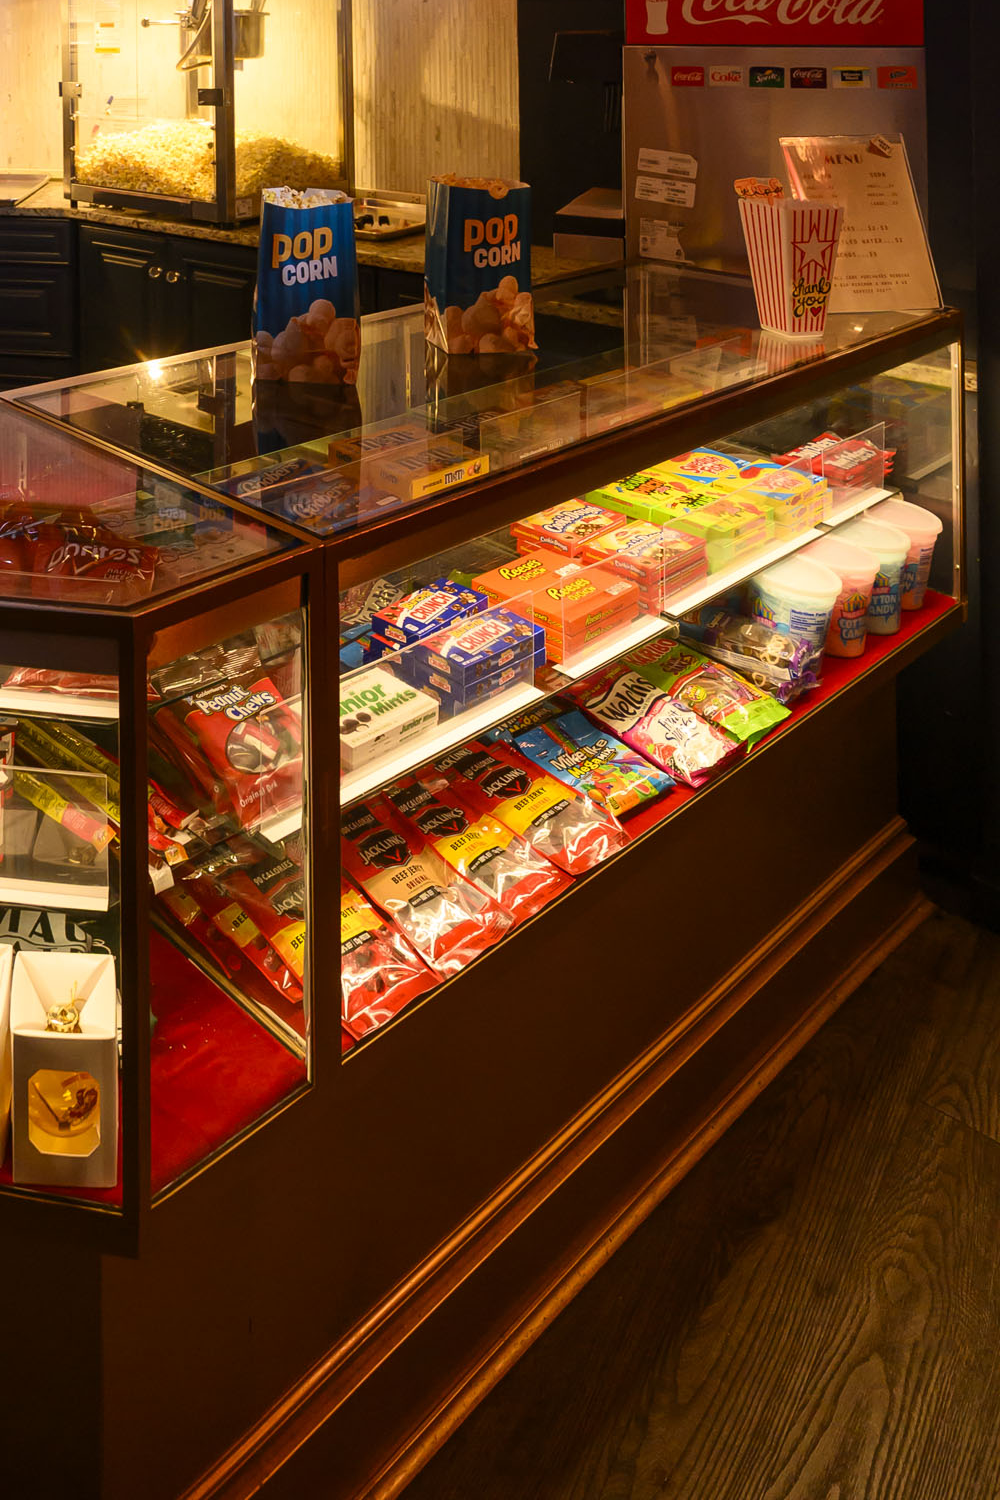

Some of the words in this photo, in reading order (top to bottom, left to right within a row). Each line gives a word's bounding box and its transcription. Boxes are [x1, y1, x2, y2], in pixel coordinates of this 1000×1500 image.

[825, 154, 863, 164] MENU
[464, 214, 518, 252] POP
[271, 227, 333, 269] POP
[474, 241, 521, 268] CORN
[282, 256, 338, 286] CORN
[498, 559, 543, 580] Reese's
[546, 577, 591, 600] Reese's
[410, 592, 454, 623] CRUNCH
[457, 620, 505, 651] CRUNCH
[196, 685, 250, 714] Peanut
[225, 691, 276, 721] Chews
[340, 683, 386, 717] unior
[368, 690, 417, 716] Mints
[596, 676, 657, 722] Welch's
[550, 749, 587, 772] Mike
[568, 757, 601, 779] Mega
[240, 785, 266, 807] Original
[482, 779, 503, 797] JACK
[513, 798, 530, 811] BEEF
[528, 787, 547, 803] JERKY
[418, 819, 438, 835] JACK
[359, 842, 381, 865] JACK
[450, 836, 467, 851] BEEF
[263, 860, 294, 881] CALORIES
[391, 869, 409, 884] BEEF
[272, 894, 296, 916] JACK
[232, 912, 249, 928] BEE
[291, 931, 306, 950] BEE
